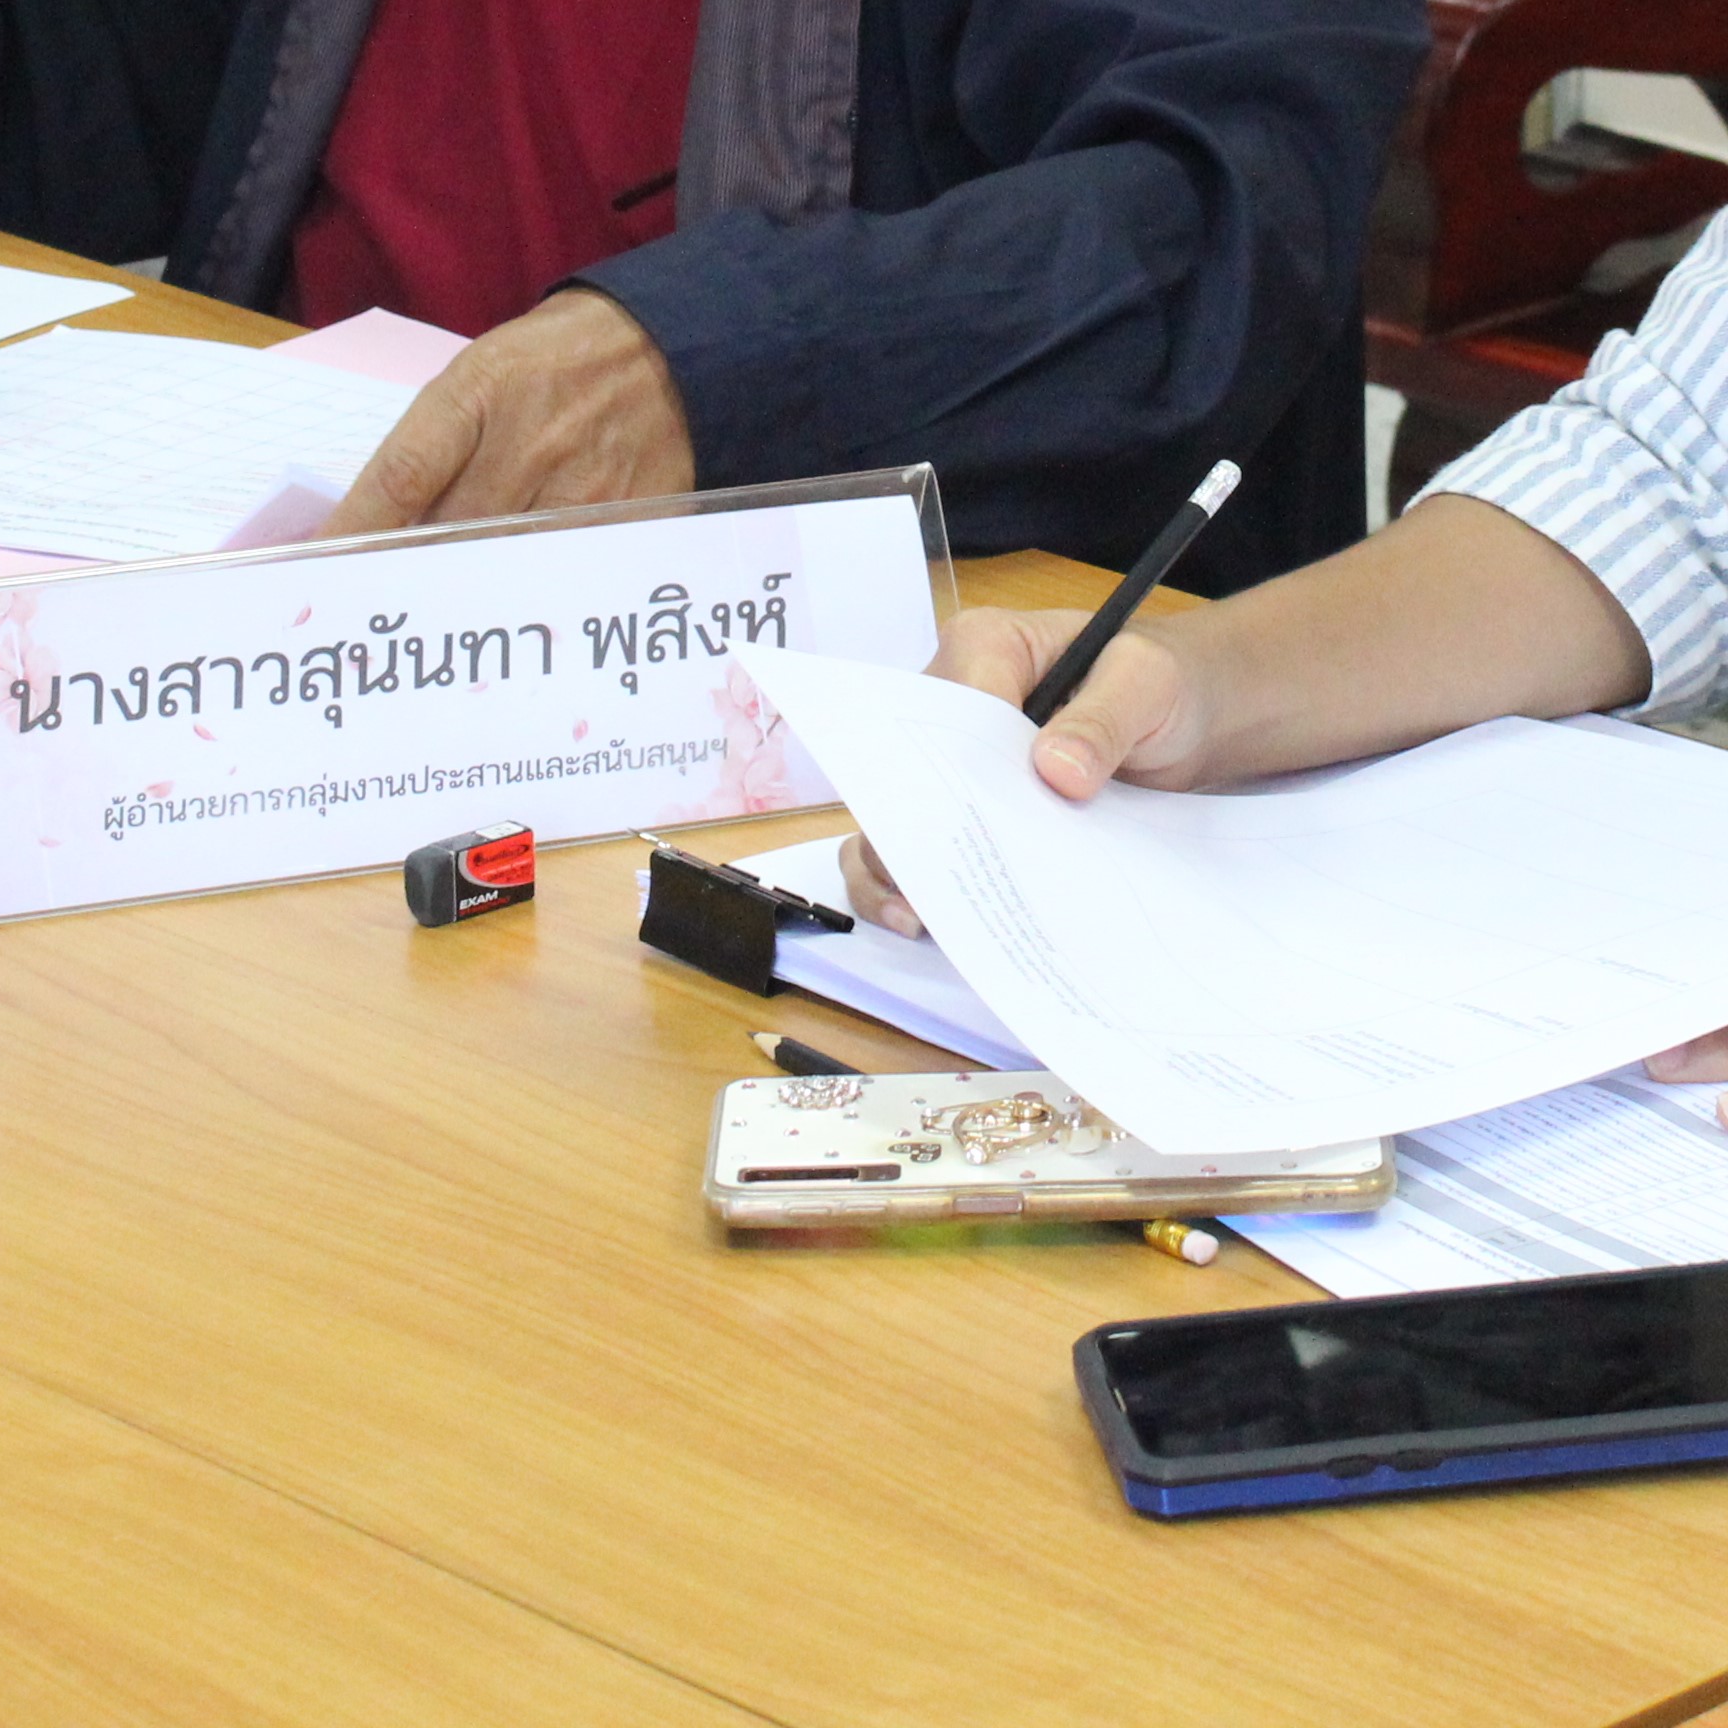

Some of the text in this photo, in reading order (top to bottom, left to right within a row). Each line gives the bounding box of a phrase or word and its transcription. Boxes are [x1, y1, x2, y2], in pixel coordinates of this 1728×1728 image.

[9, 572, 792, 734] นางสาวสุนันทา พุสิงห์
[103, 737, 729, 841] ผู้อำนวยการกลุ่มงานประสานและสนับสนุนฯ
[459, 890, 498, 910] EXAM
